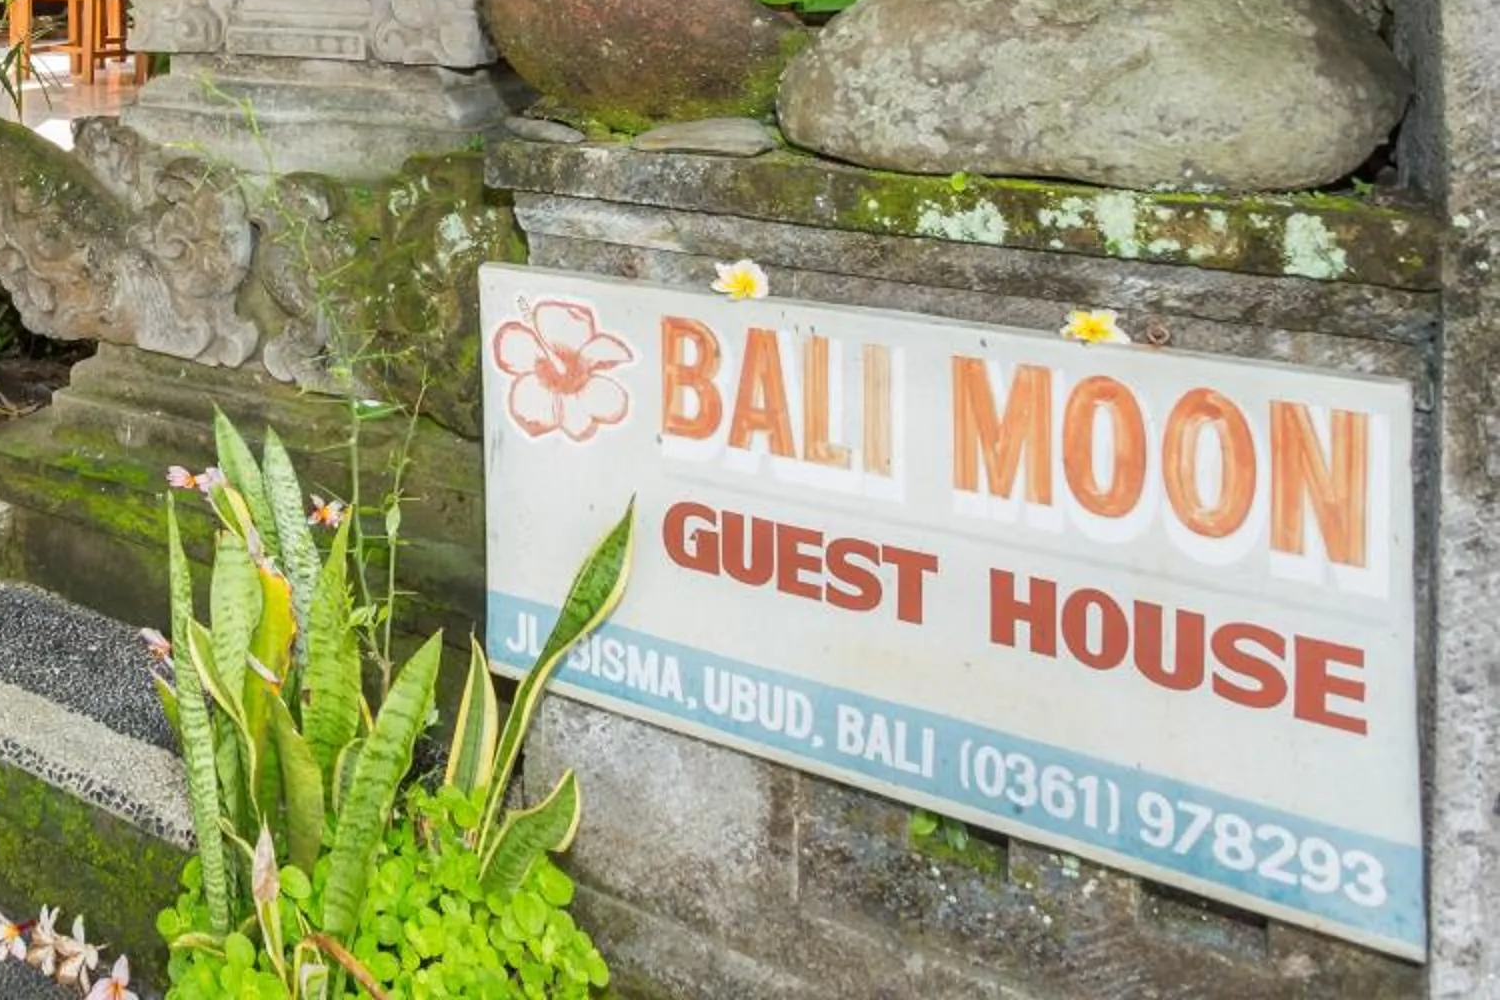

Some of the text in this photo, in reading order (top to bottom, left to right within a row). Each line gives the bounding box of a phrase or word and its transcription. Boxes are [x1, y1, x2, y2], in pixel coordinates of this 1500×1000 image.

[661, 315, 1369, 569] BALI MOON
[662, 501, 1368, 736] GUEST HOUSE
[703, 665, 824, 748] UBUD,
[837, 704, 935, 778] BALI
[960, 738, 1120, 835] (0361)
[1136, 790, 1388, 907] 978293
